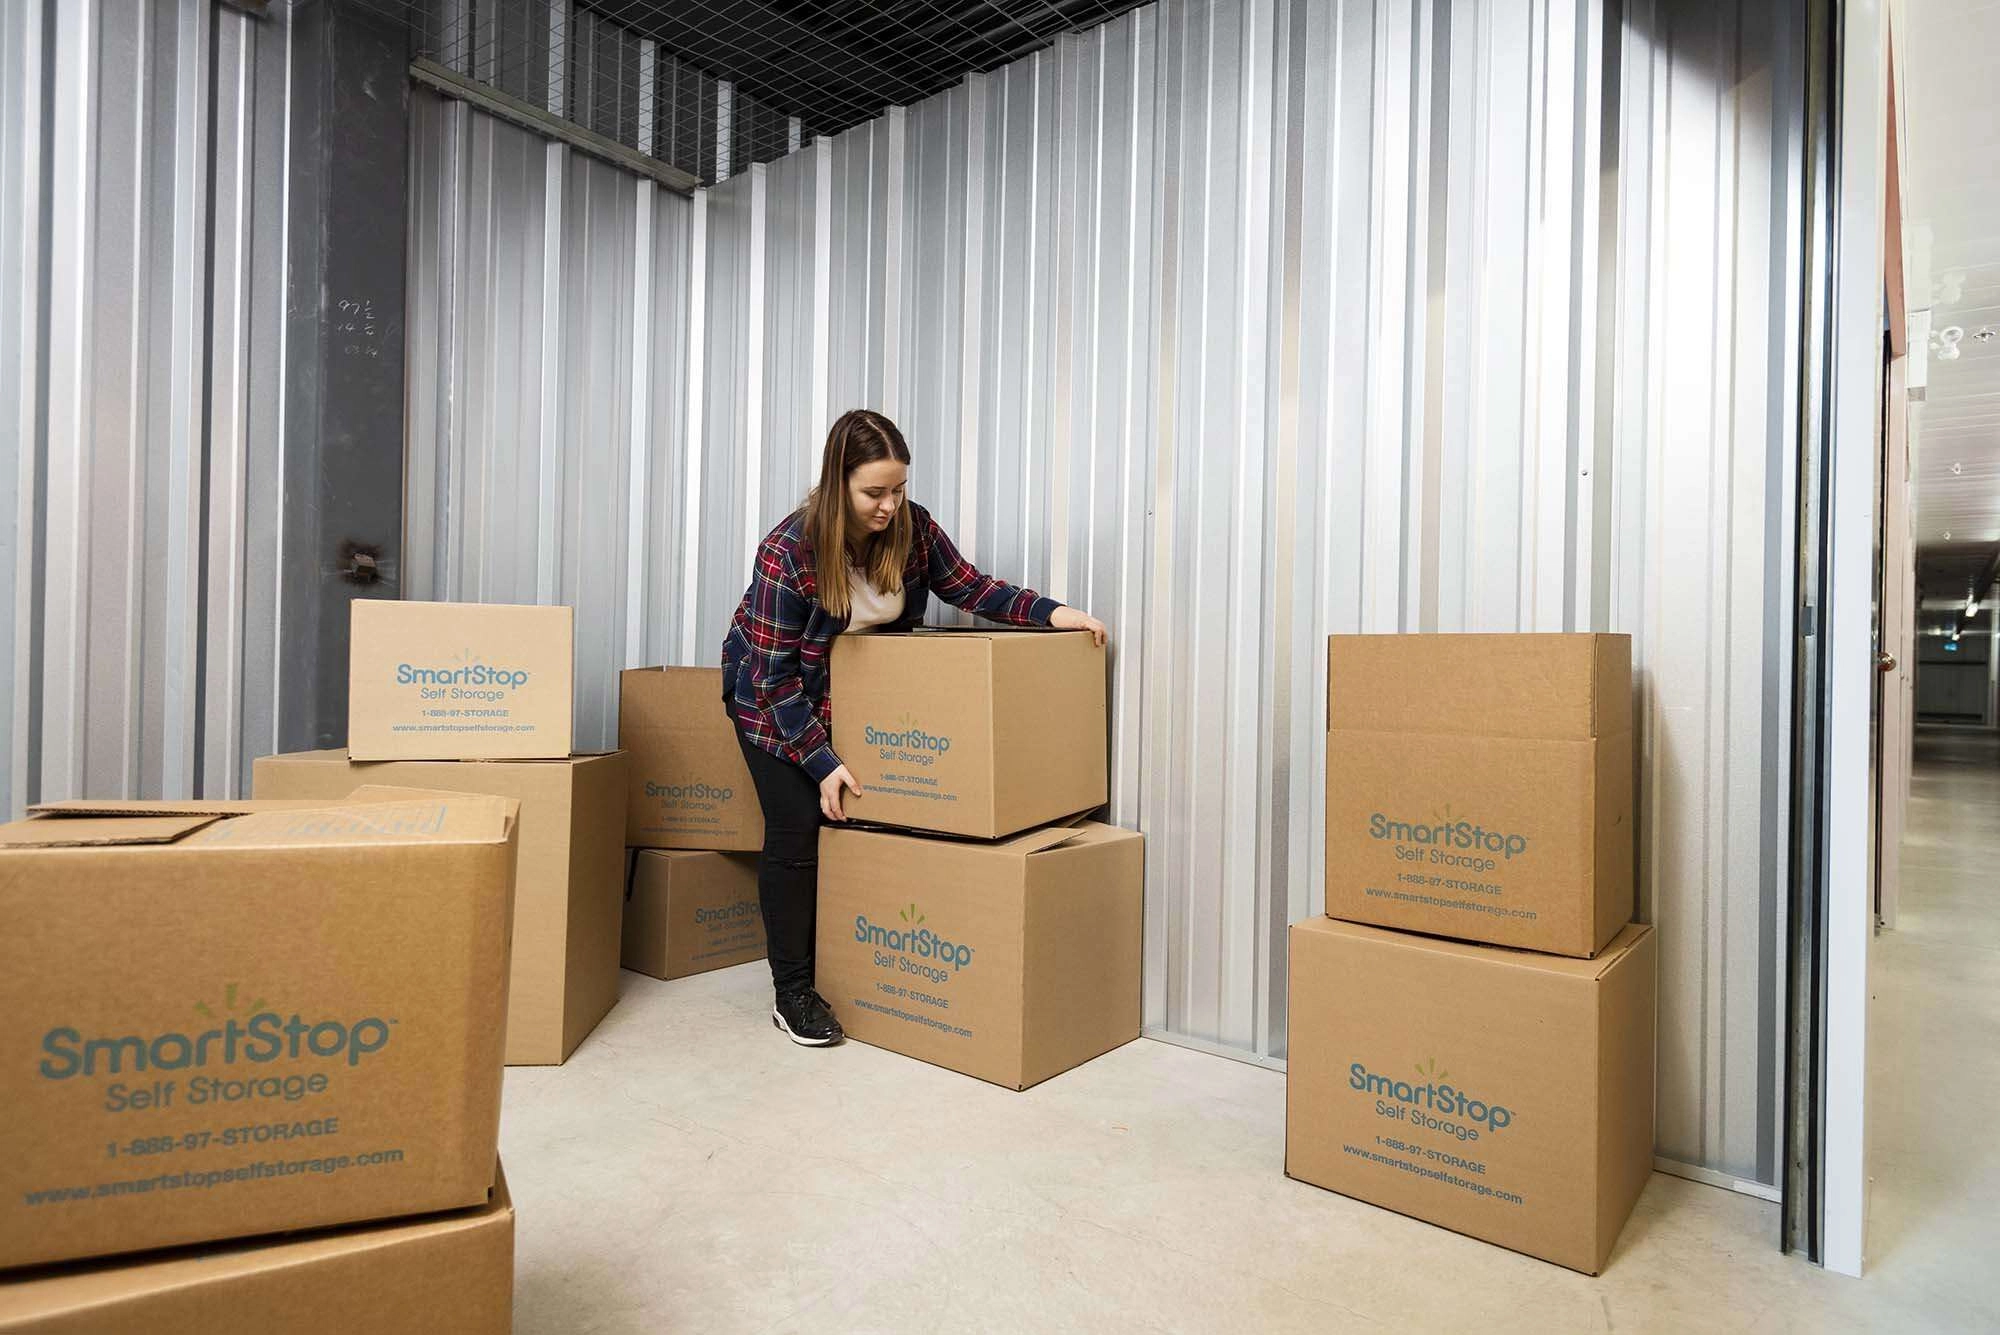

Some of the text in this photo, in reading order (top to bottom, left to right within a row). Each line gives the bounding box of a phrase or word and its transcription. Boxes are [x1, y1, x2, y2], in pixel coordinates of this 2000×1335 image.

[396, 664, 528, 690] SmartStop
[420, 687, 505, 703] Self Storage
[865, 725, 950, 757] SmartStop
[879, 748, 934, 766] Self Storage
[644, 781, 734, 802] SmartStop
[1368, 812, 1527, 860] SmartStop
[1395, 844, 1496, 873] Self Storage
[1365, 886, 1537, 920] www.smartstopselfstorage.com
[1397, 872, 1503, 896] 1-888-97-STORAGE
[855, 915, 972, 971] SmartStop
[874, 950, 949, 984] Self Storage
[876, 982, 950, 1009] 1-888-97-STORAGE
[853, 998, 973, 1039] www.smartstopselfstorage.com
[40, 1011, 389, 1080] SmartStop
[105, 1071, 329, 1113] Self Storage
[1349, 1063, 1511, 1132] SmartStop
[107, 1118, 339, 1158] 1-888-97-STORAGE
[1375, 1099, 1480, 1141] Self Storage
[1343, 1144, 1523, 1206] www.smartstopselfstorage.com
[1375, 1135, 1487, 1175] 1-888-97-STORAGE
[25, 1148, 404, 1206] www.smartstopselfstorage.com
